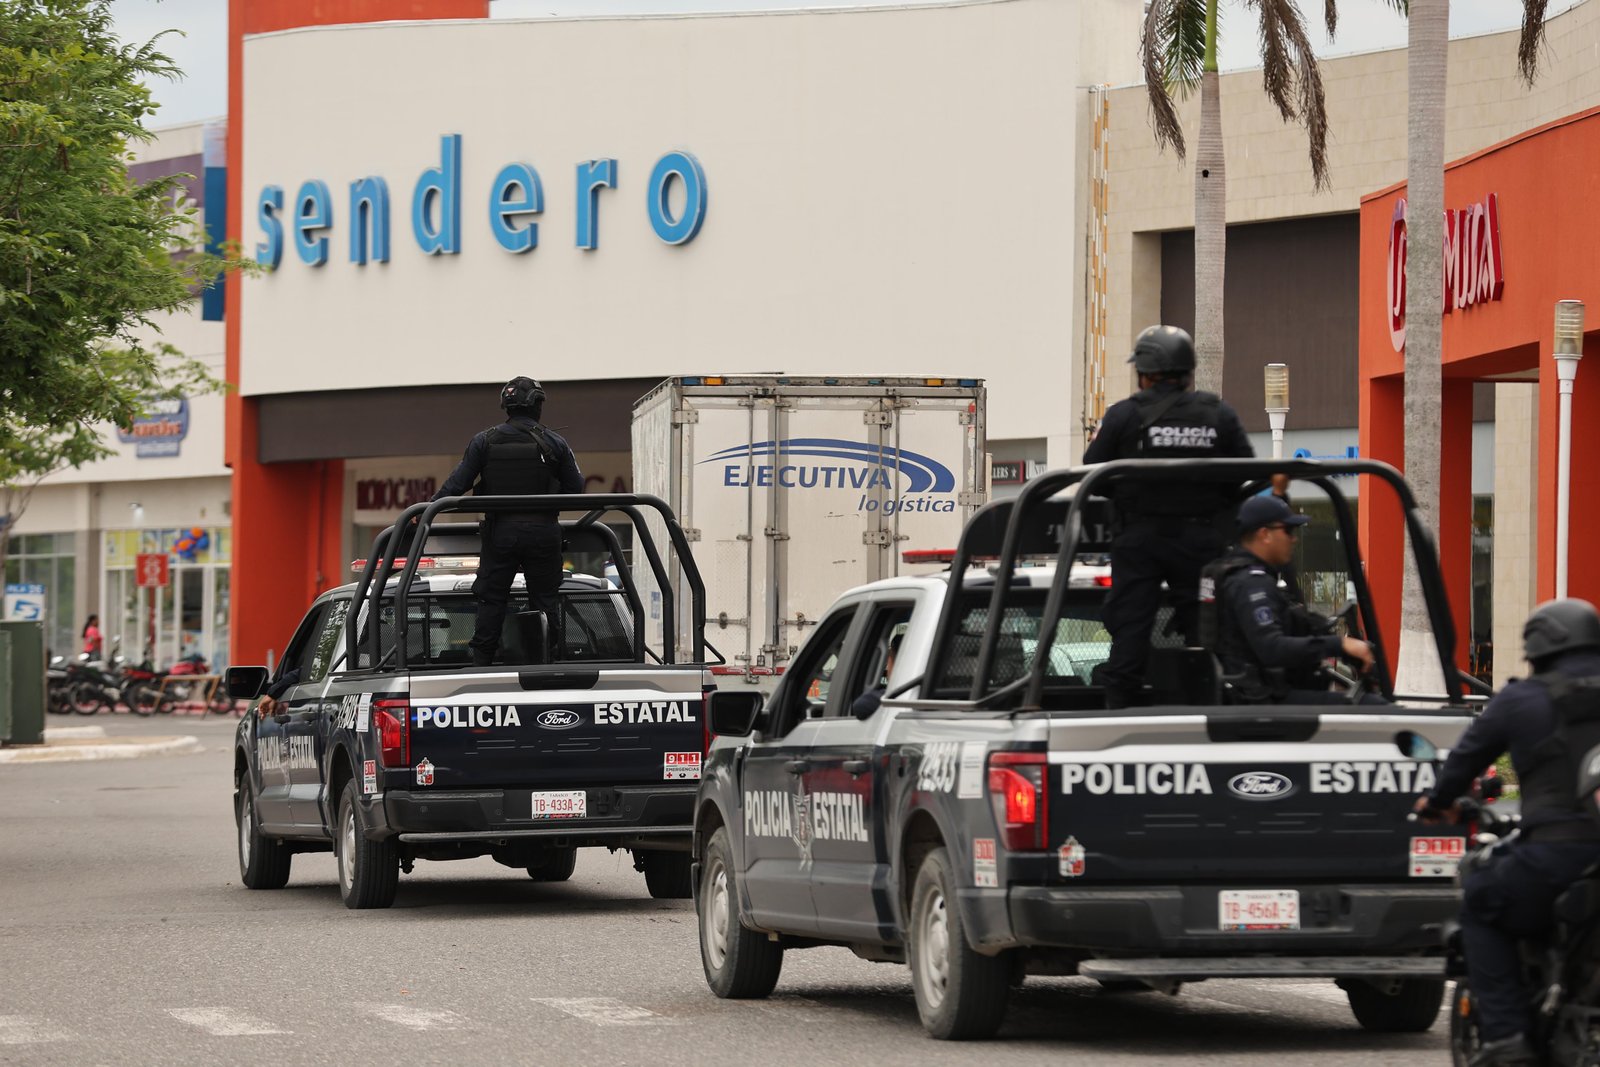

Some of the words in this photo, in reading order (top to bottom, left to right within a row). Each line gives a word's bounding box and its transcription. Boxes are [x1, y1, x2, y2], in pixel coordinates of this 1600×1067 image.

[256, 133, 708, 270] sendero
[1152, 436, 1214, 447] ESTATAL
[724, 465, 892, 489] EJECUTIVA
[857, 494, 956, 516] logística
[417, 706, 521, 728] POLICIA
[594, 702, 696, 724] ESTATAL
[542, 712, 573, 725] Ford
[289, 735, 317, 769] ESTATAL
[667, 754, 698, 763] 911
[1061, 763, 1212, 795] POLICIA
[1309, 762, 1440, 794] ESTATA
[1236, 774, 1283, 793] Ford
[534, 798, 585, 811] TB-433A-2
[745, 791, 793, 838] POLICIA
[812, 792, 869, 842] ESTATAL
[1416, 840, 1459, 854] 911
